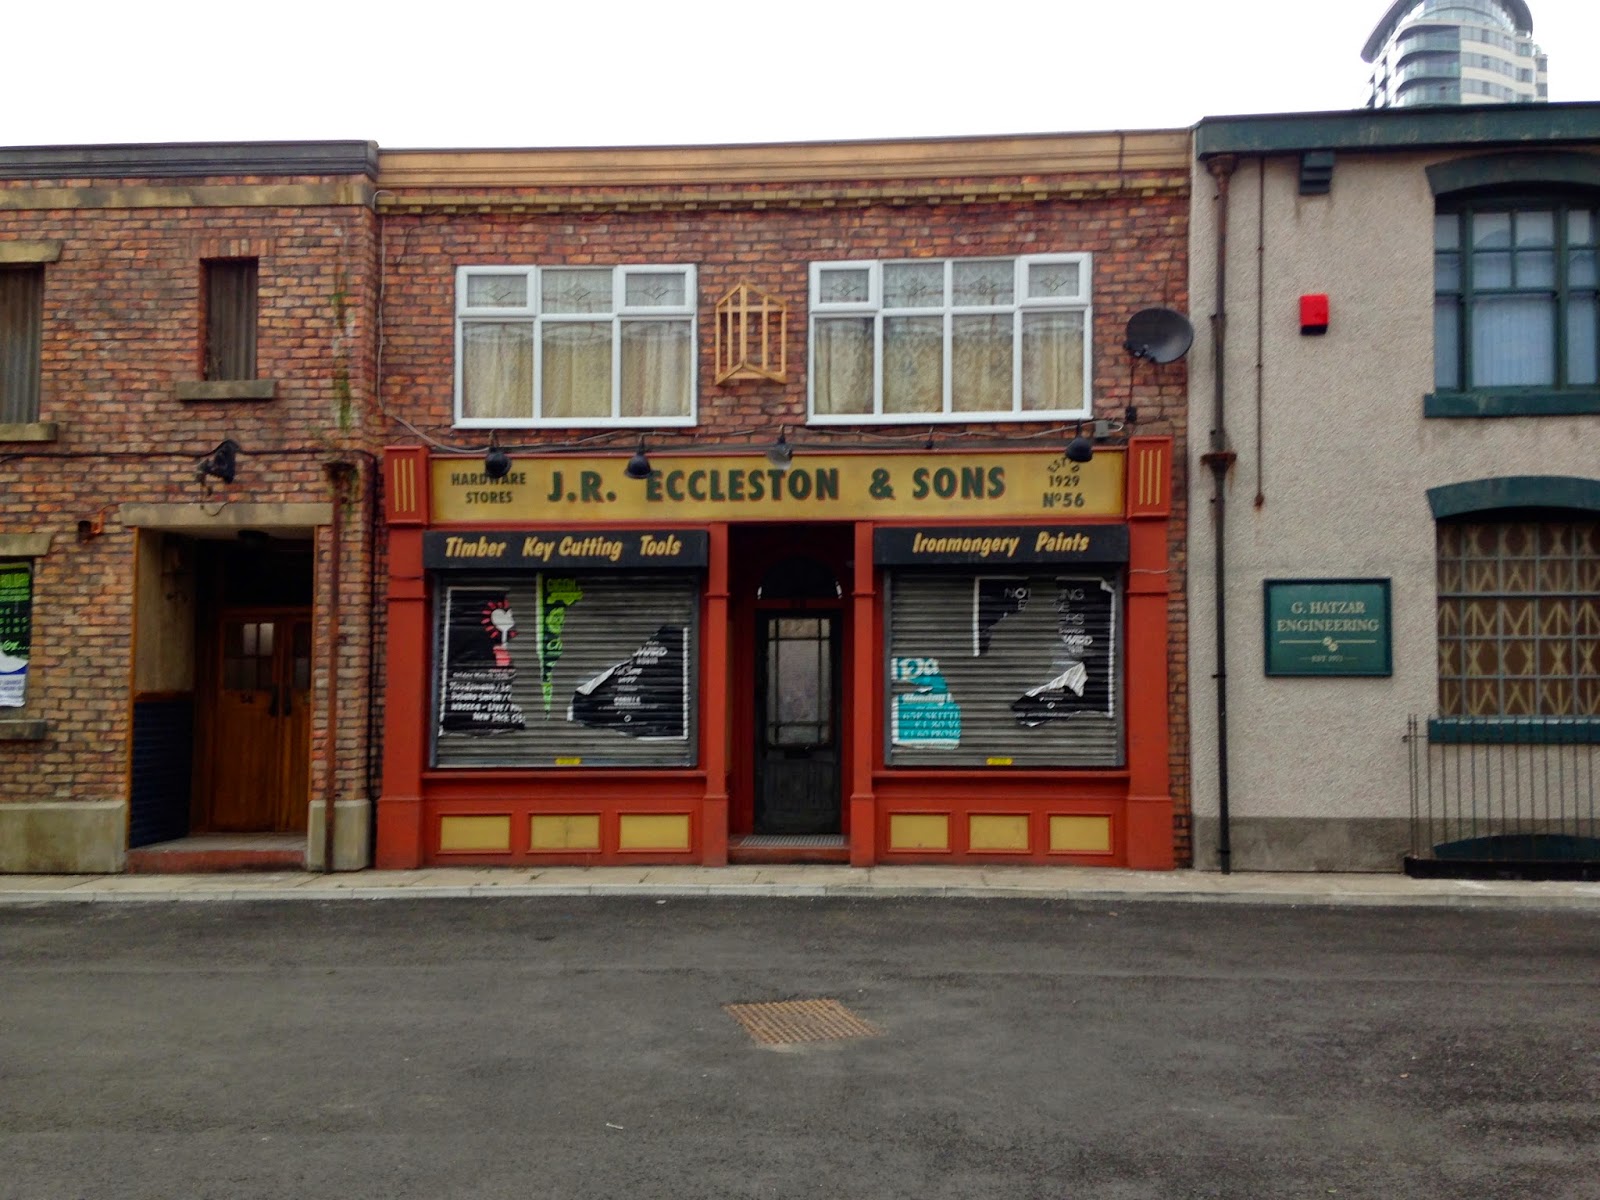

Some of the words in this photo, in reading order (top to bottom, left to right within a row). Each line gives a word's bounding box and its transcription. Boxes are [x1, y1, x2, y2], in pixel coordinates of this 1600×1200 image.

[547, 470, 616, 503] J.R.
[646, 469, 839, 502] ECCLESTON
[869, 468, 895, 500] &
[912, 466, 1006, 500] SONS
[1049, 475, 1080, 487] 1929
[465, 491, 513, 504] STORES
[445, 536, 506, 558] Timber
[522, 537, 553, 562] Key
[558, 536, 623, 562] Cutting
[639, 534, 682, 556] Tools
[912, 533, 1020, 557] Ironmongery
[1035, 532, 1090, 553] Paints
[1310, 601, 1366, 614] HATZAR
[1277, 619, 1379, 632] ENGINEERING
